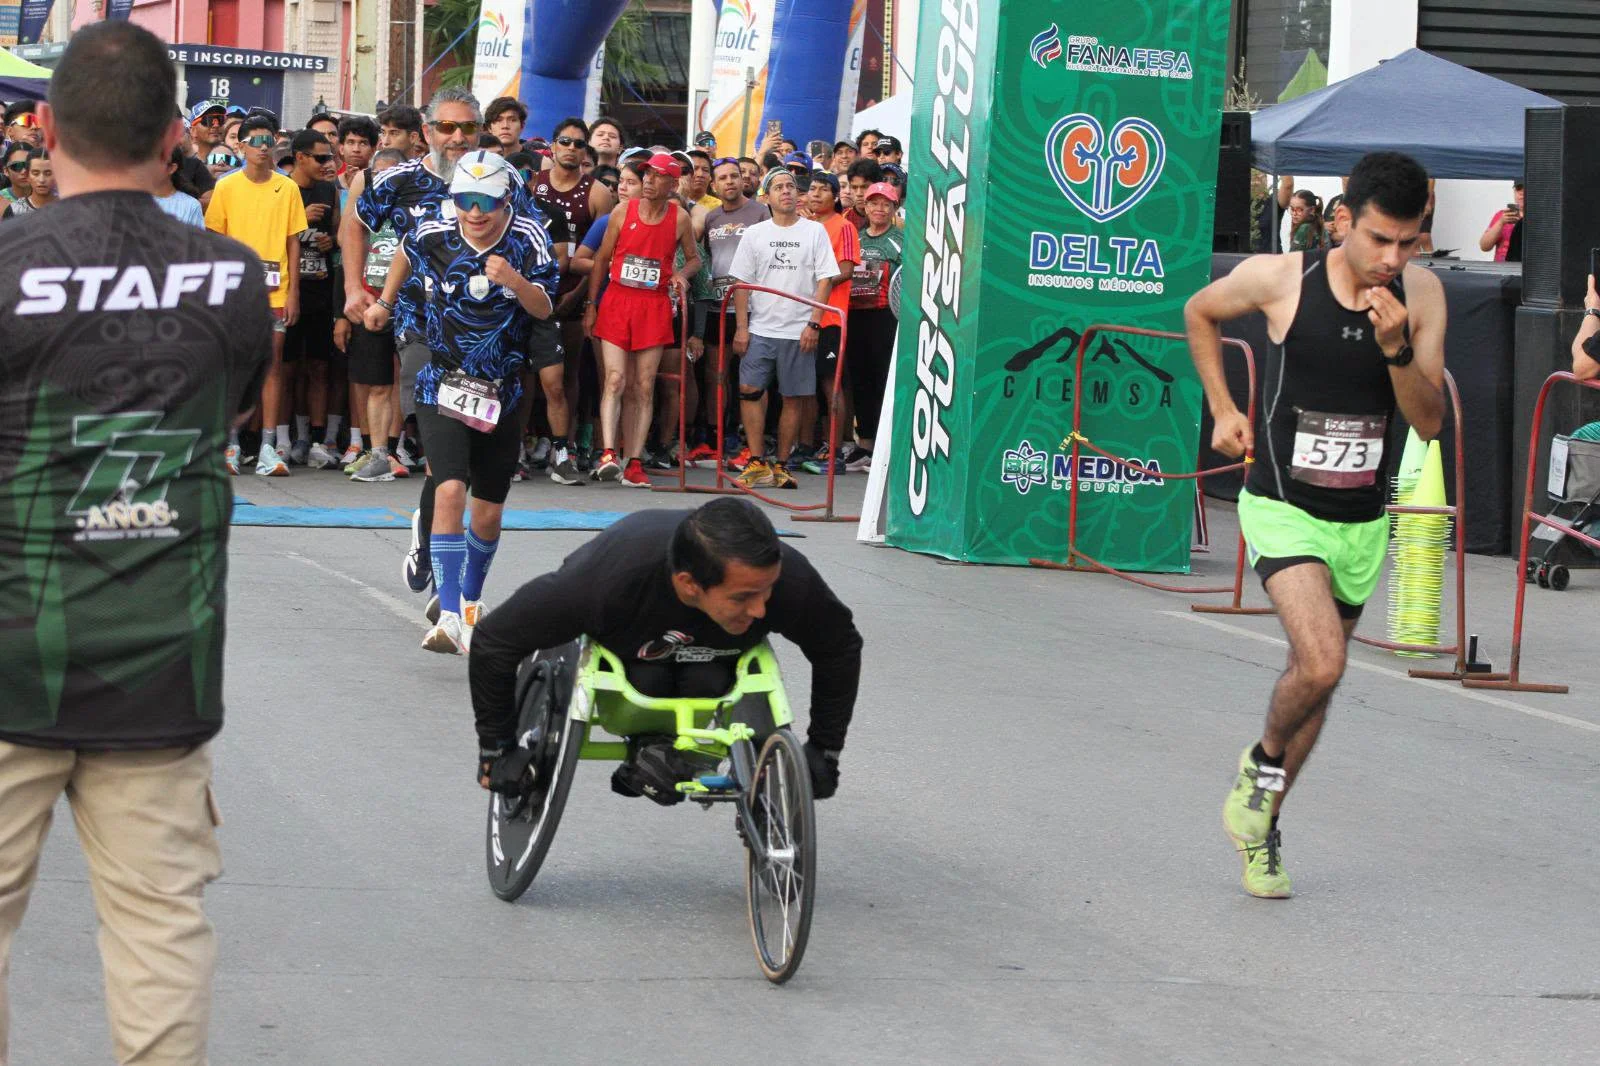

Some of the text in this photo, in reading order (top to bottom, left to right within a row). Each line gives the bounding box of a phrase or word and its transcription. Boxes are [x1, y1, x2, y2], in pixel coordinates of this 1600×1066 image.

[1068, 35, 1099, 46] GRUPO
[194, 51, 325, 70] INSCRIPCIONES
[1066, 43, 1193, 73] FANAFESA
[210, 78, 230, 97] 18
[930, 0, 979, 460] TU SALUD
[769, 241, 800, 249] CROSS
[1029, 232, 1164, 278] DELTA
[625, 265, 659, 282] 1913
[1028, 273, 1164, 293] INSUMOS MÉDICOS
[14, 261, 246, 316] STAFF
[908, 181, 945, 516] CORRE
[1004, 375, 1174, 408] CIEMSA
[453, 394, 481, 415] 41
[1309, 439, 1369, 468] 573
[1053, 454, 1164, 486] MEDICA
[1051, 480, 1134, 494] LAGUNA
